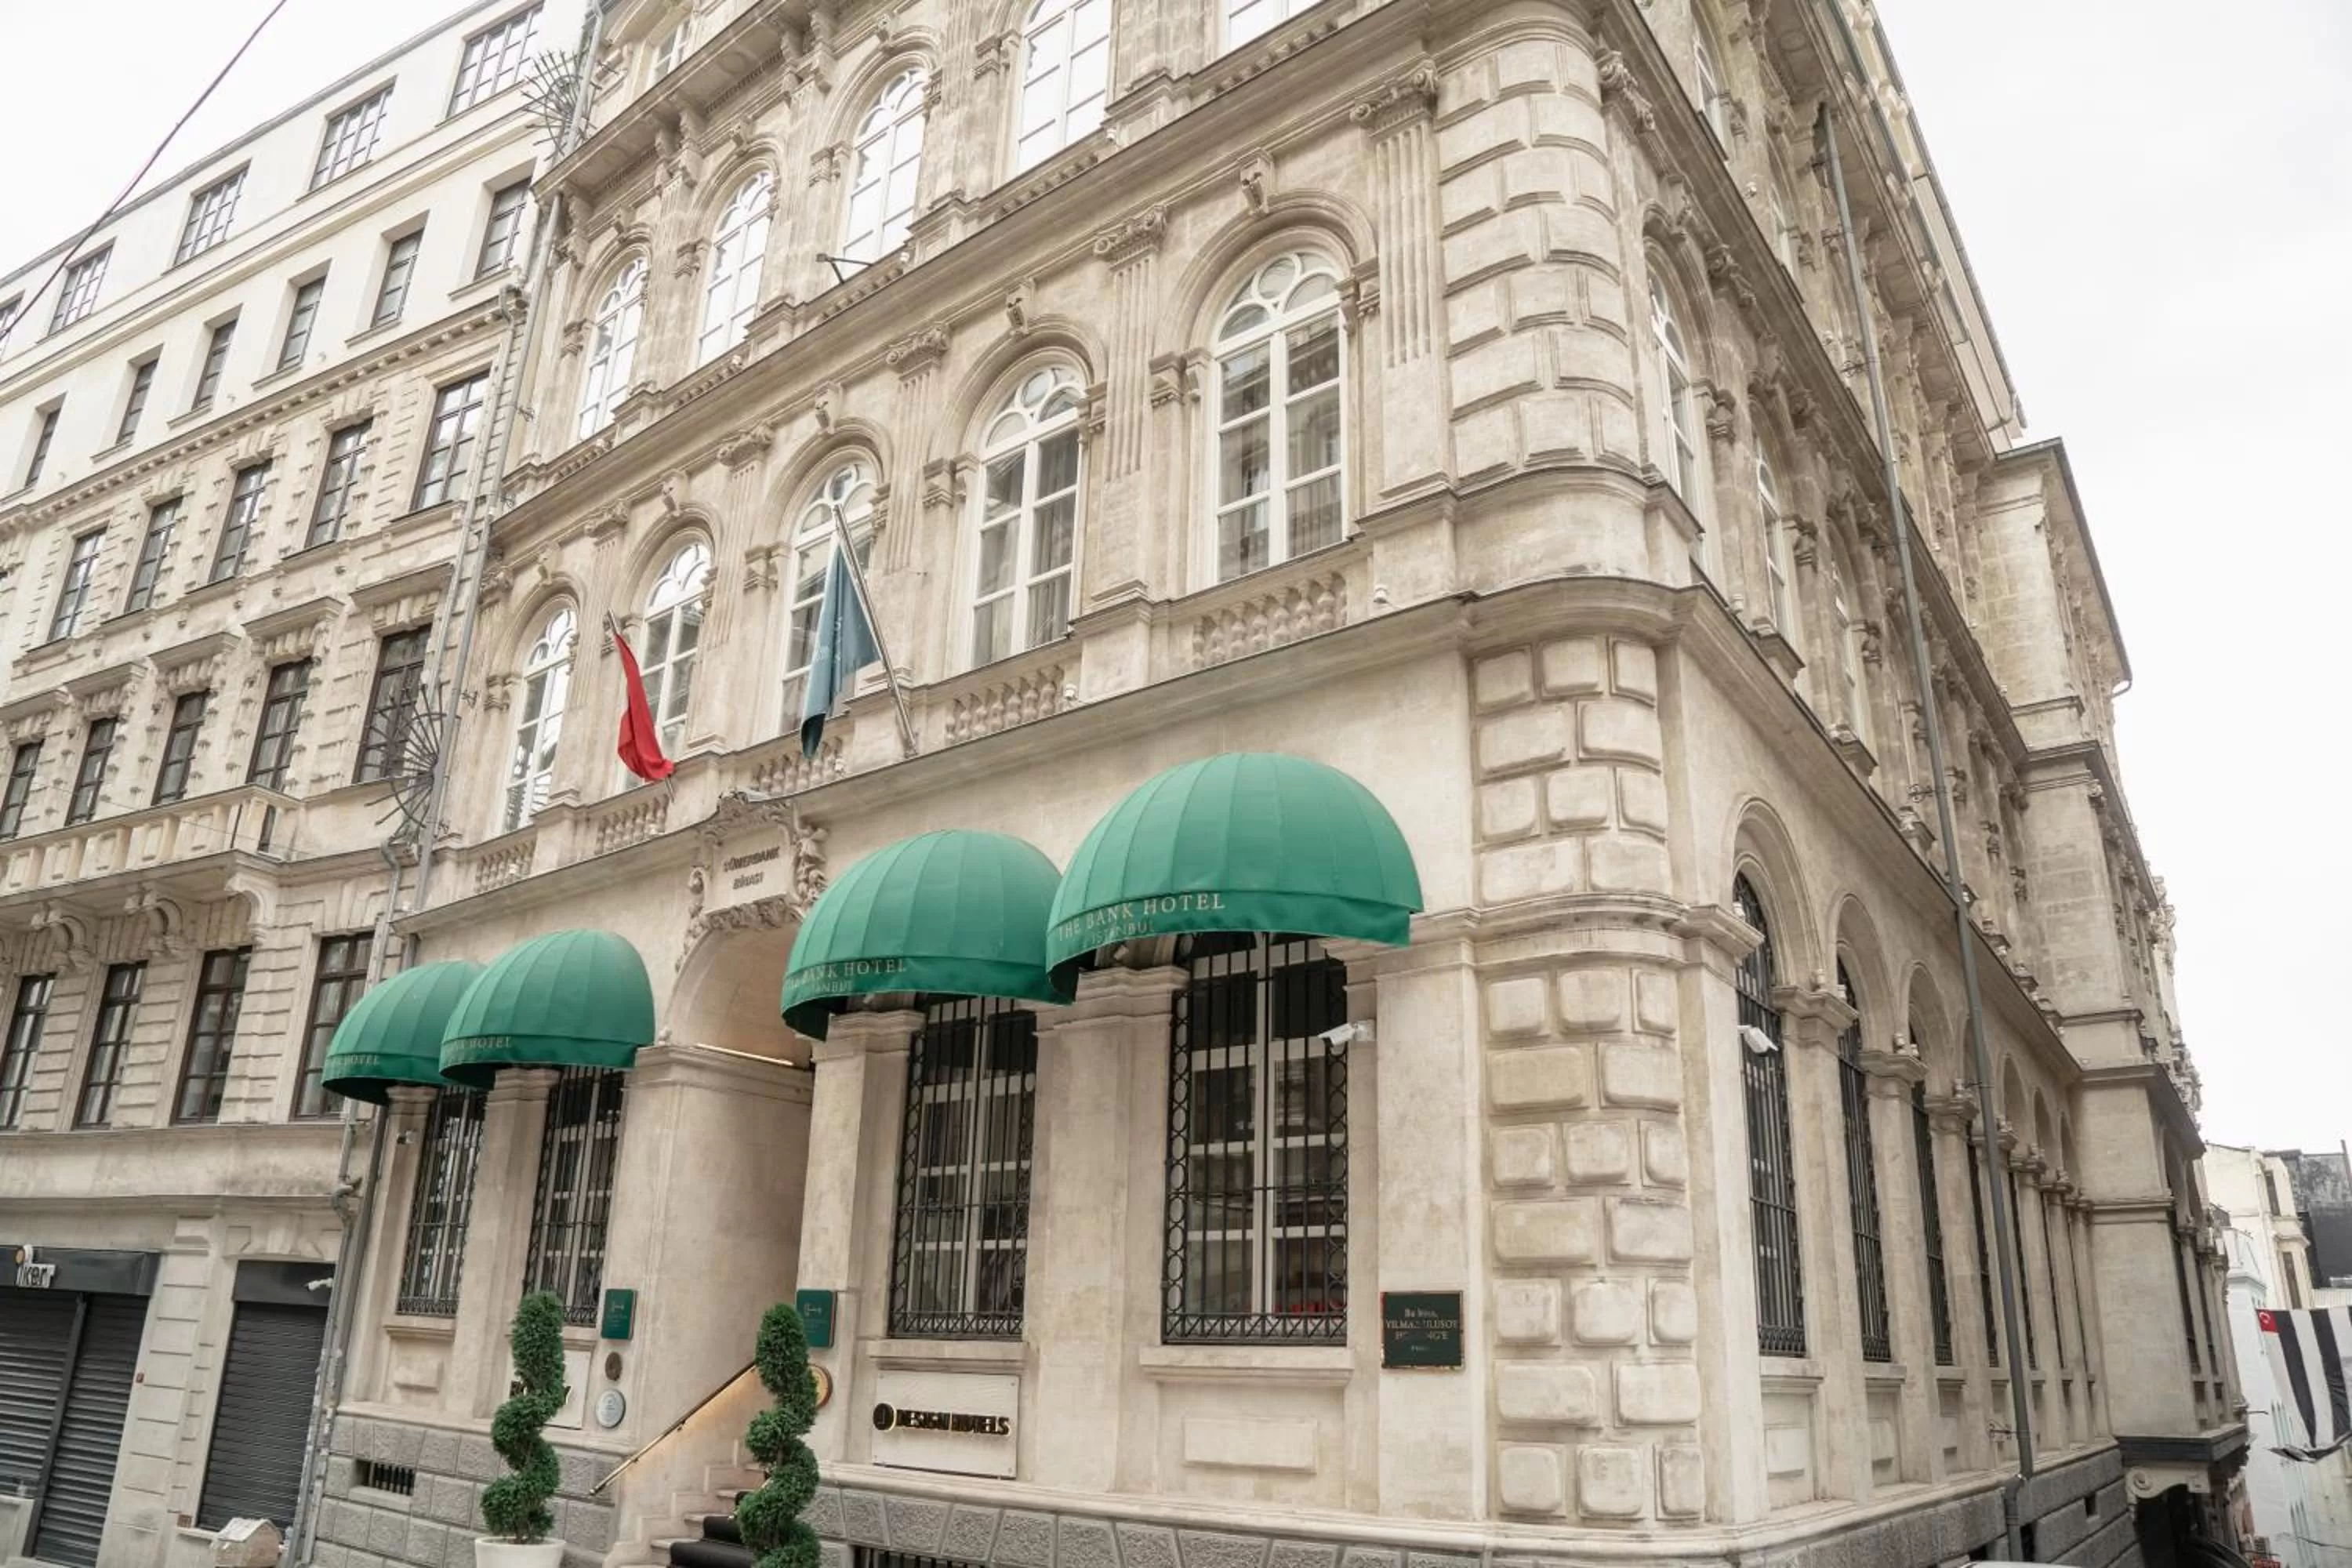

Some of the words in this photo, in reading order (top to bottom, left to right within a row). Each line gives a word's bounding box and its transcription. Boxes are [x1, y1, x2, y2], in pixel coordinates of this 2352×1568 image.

[1086, 902, 1134, 930] BANK
[1144, 892, 1226, 916] HOTEL
[844, 957, 907, 976] HOTEL
